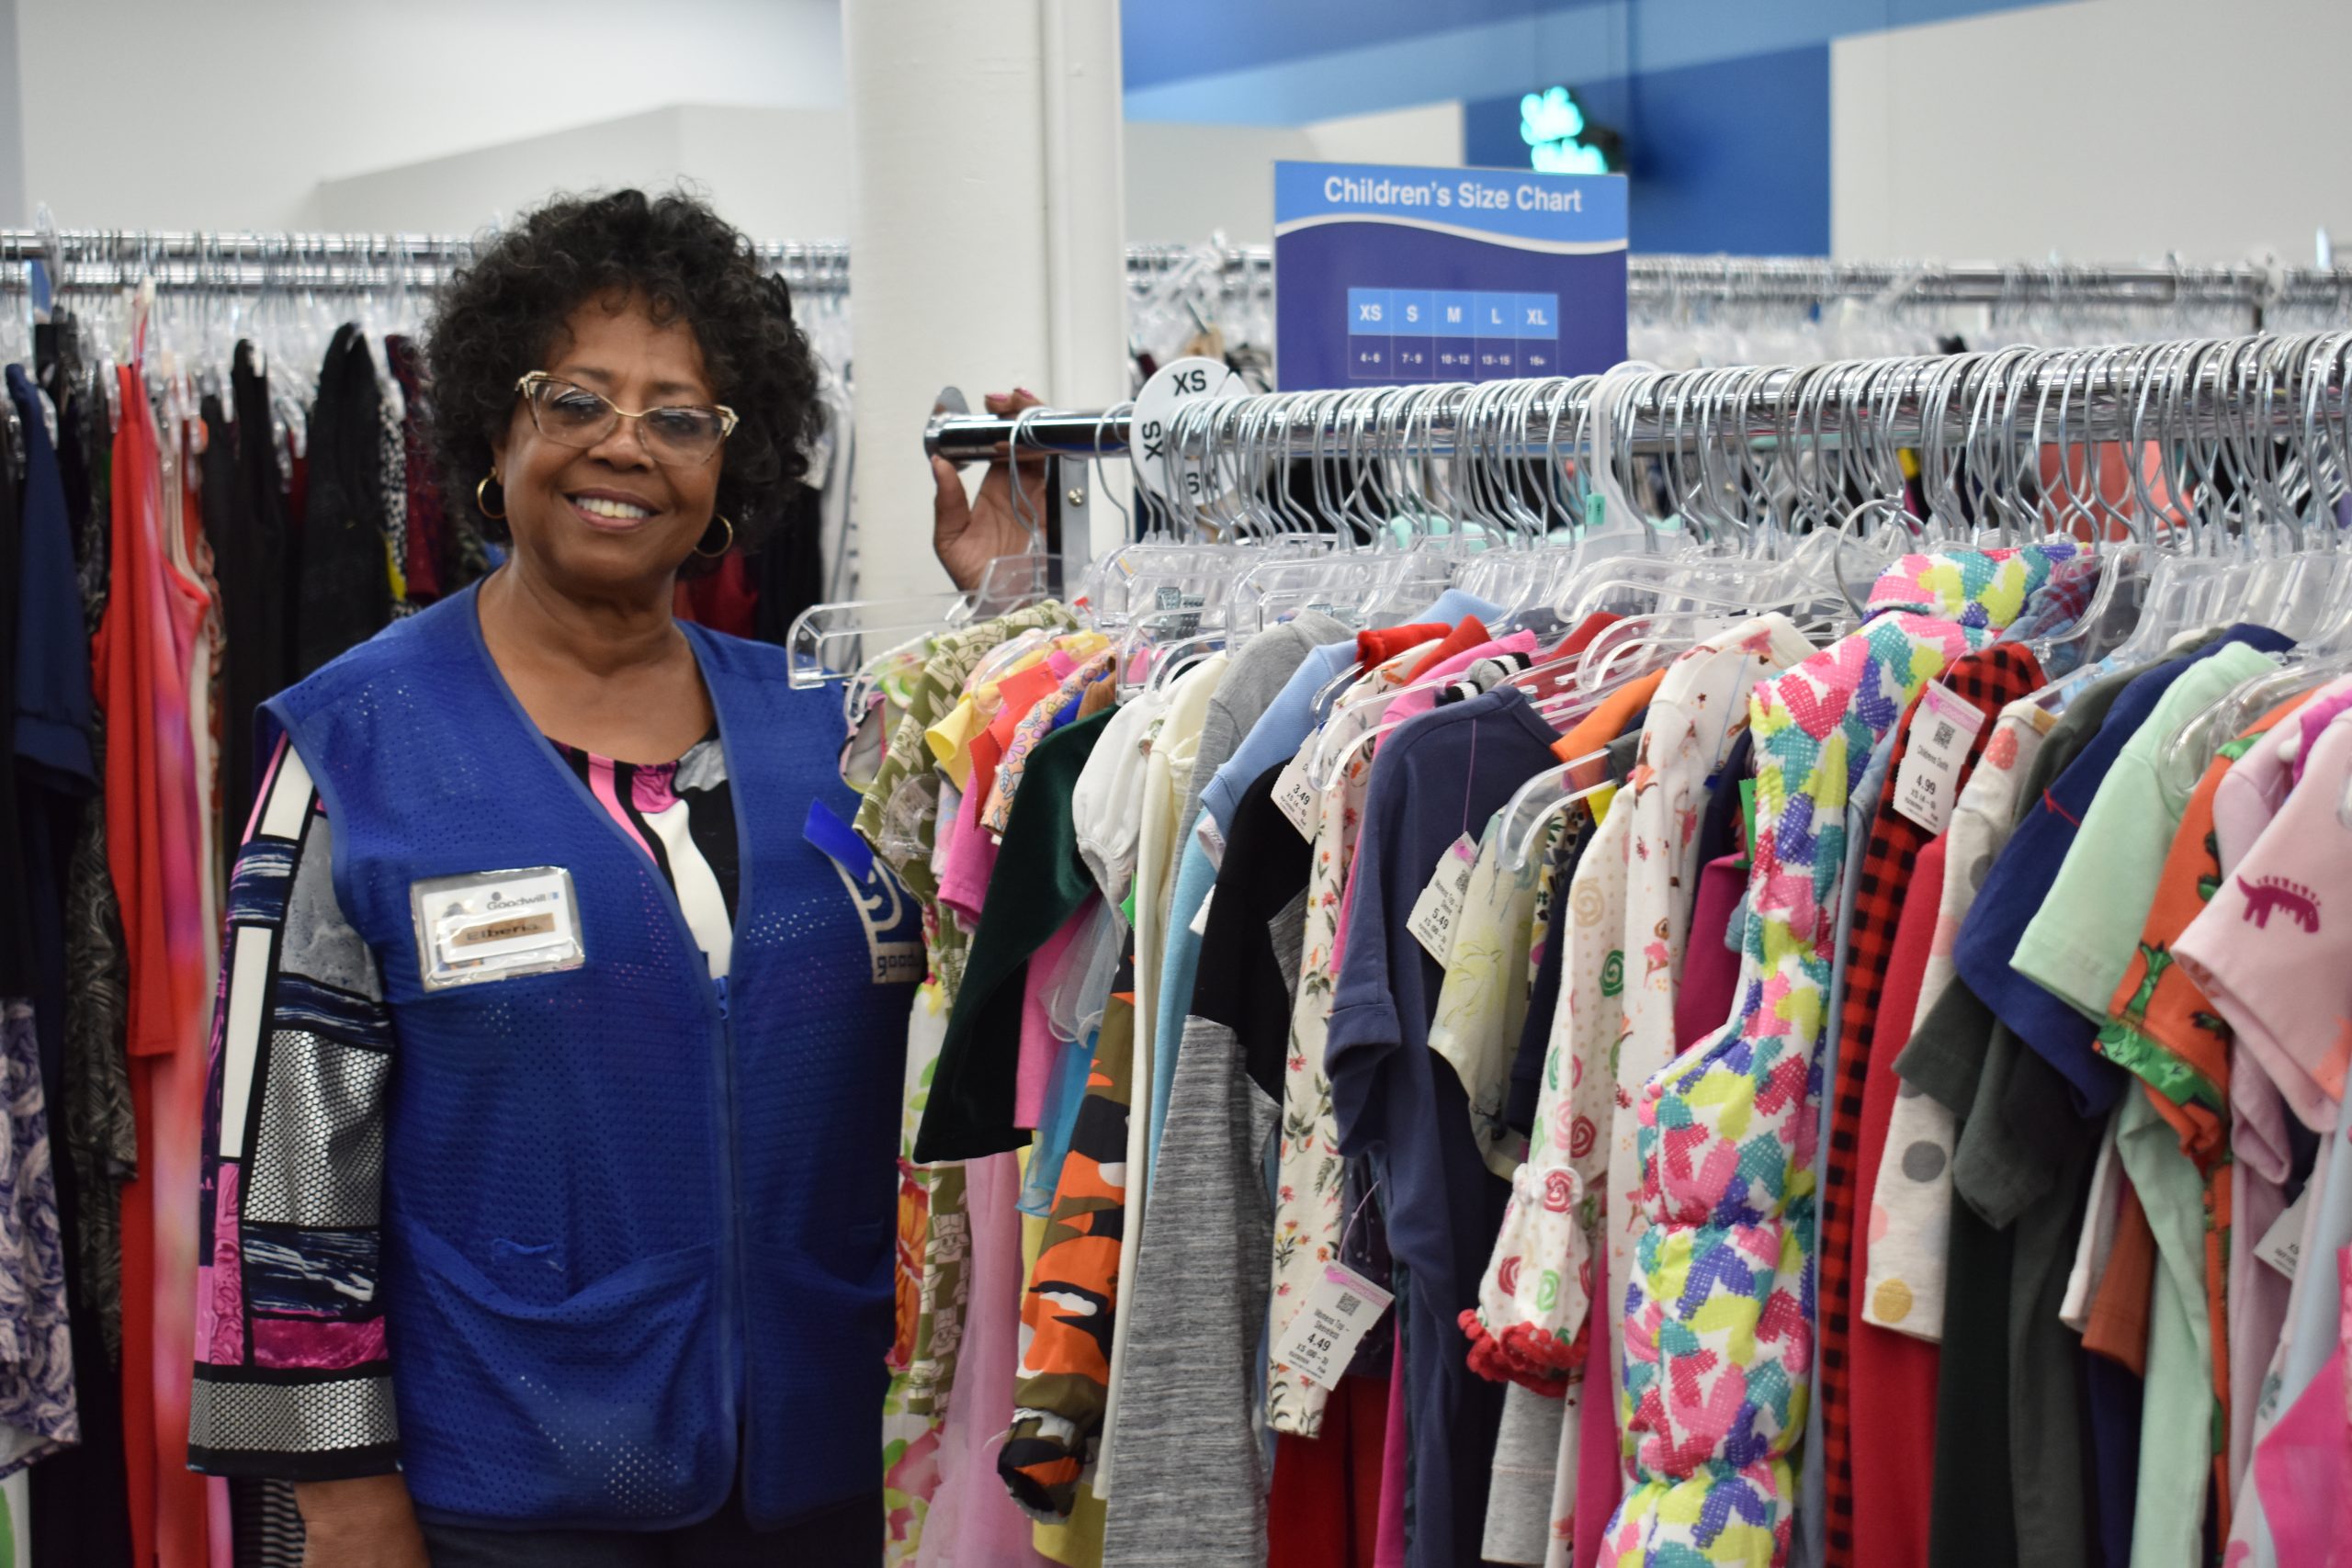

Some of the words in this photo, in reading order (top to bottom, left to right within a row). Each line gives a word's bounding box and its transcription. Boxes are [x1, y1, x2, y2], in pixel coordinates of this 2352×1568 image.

[1324, 175, 1452, 208] Children's
[1458, 182, 1510, 210] Size
[1516, 185, 1582, 212] Chart
[1359, 304, 1382, 321] XS
[1407, 306, 1419, 322] S
[1447, 307, 1462, 323] M
[1491, 309, 1501, 324] L
[1527, 310, 1547, 326] XL
[1172, 369, 1206, 396] XS
[1141, 421, 1163, 461] XS
[1293, 784, 1311, 806] 3.49
[1916, 773, 1937, 795] 4.99
[487, 893, 547, 910] Goodwill
[1431, 908, 1450, 931] 5.49
[1307, 1333, 1332, 1352] 4.49
